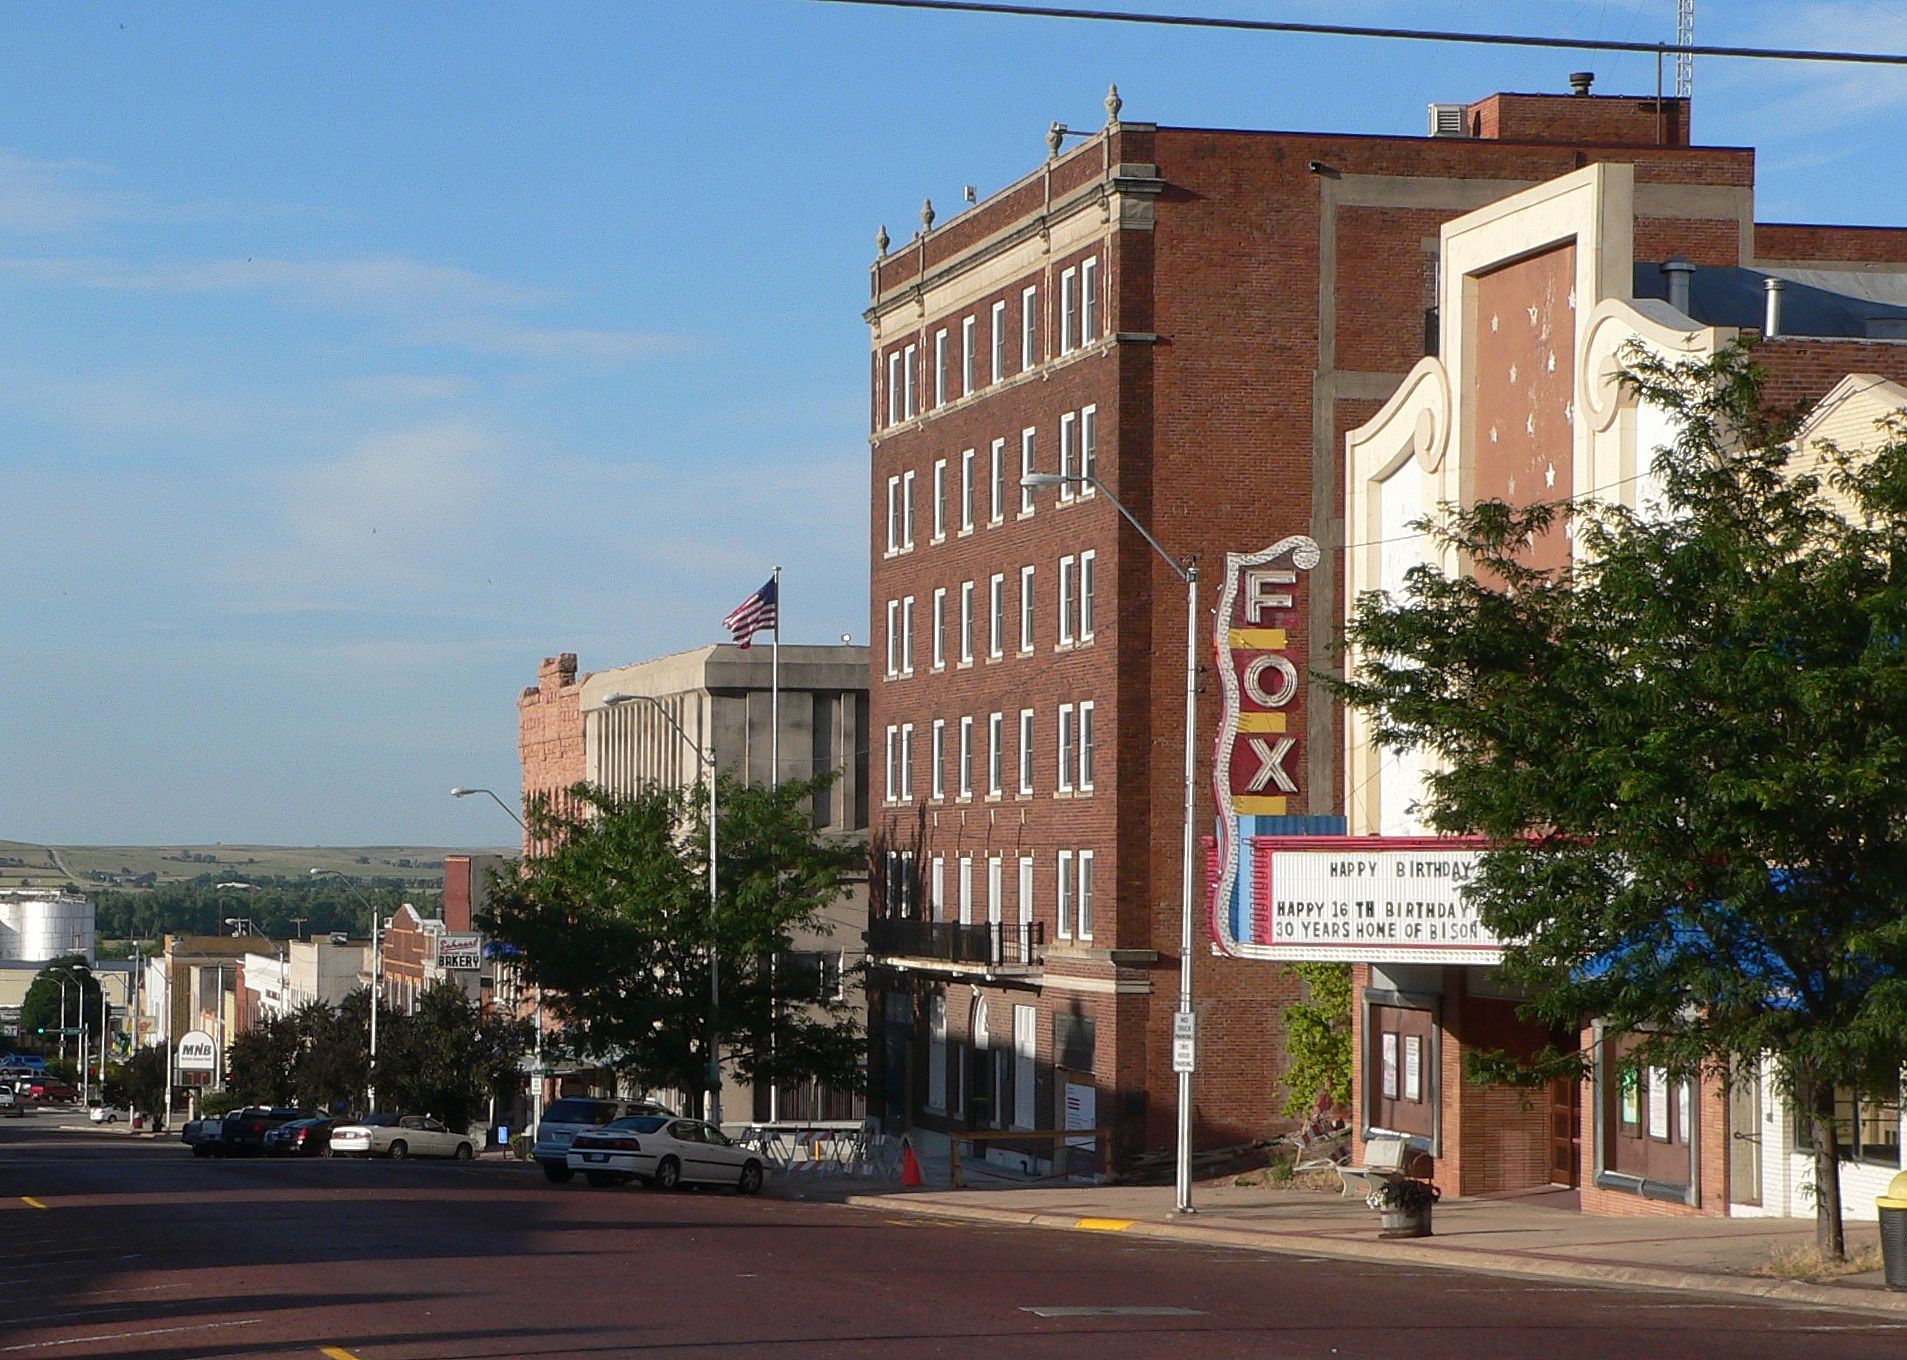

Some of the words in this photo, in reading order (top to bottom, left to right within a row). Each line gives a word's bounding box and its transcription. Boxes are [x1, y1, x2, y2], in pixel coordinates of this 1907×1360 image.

[1244, 569, 1298, 793] FOX
[1330, 861, 1377, 877] HAPPY
[1396, 860, 1471, 879] BIRTHDAY
[1277, 901, 1325, 917] HAPPY
[1332, 901, 1348, 918] 16
[1355, 901, 1375, 918] TH
[1385, 901, 1468, 919] BIRTHDAY
[1276, 921, 1294, 937] 30
[1301, 921, 1350, 938] YEARS
[1356, 922, 1396, 938] HOME
[1405, 922, 1422, 938] OF
[1430, 922, 1477, 939] BISON
[438, 955, 479, 967] BAKERY
[182, 1043, 212, 1056] MNB
